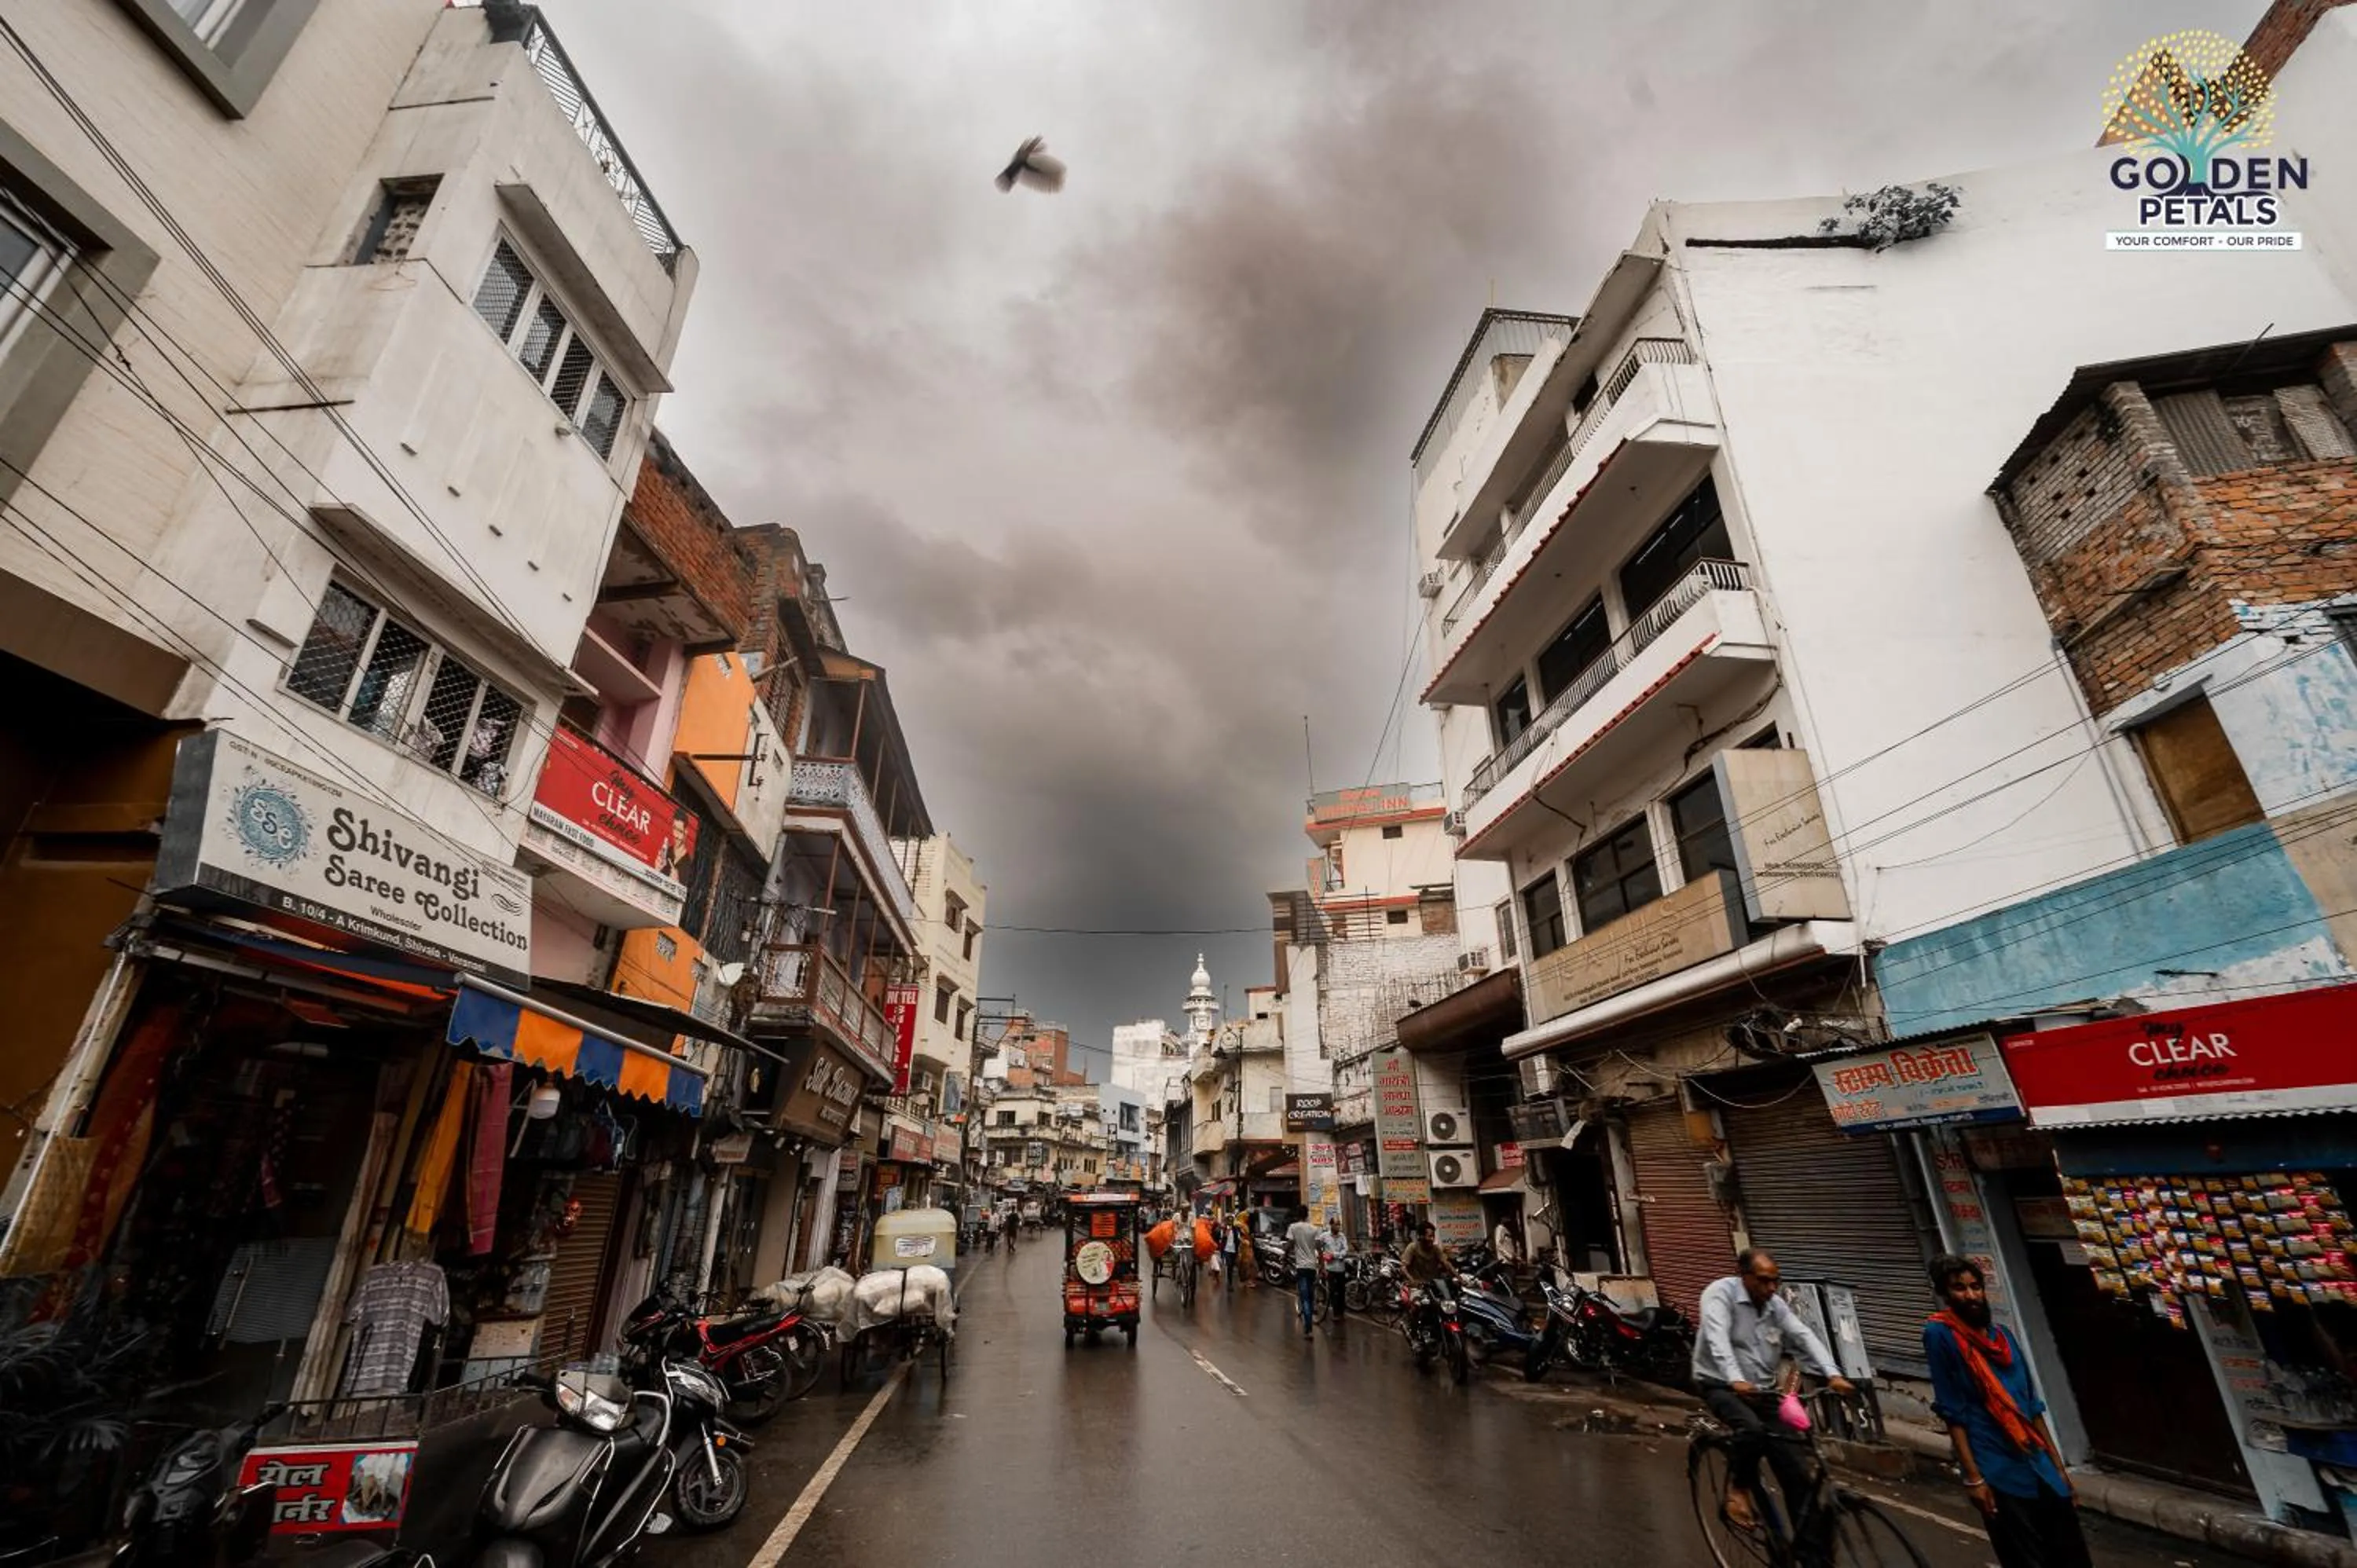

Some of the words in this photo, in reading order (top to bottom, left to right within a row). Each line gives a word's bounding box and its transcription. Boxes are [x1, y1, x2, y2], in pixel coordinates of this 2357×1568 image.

[591, 781, 651, 835] CLEAR
[327, 807, 481, 901] Shivangi
[324, 853, 405, 904] Saree
[414, 889, 528, 951] Collection
[370, 905, 423, 931] Wholesaler
[335, 914, 346, 927] A
[1888, 1044, 1978, 1084] विक्रेता
[2128, 1032, 2238, 1067] CLEAR
[2152, 1059, 2231, 1082] choice
[273, 1493, 336, 1523] ार्नर
